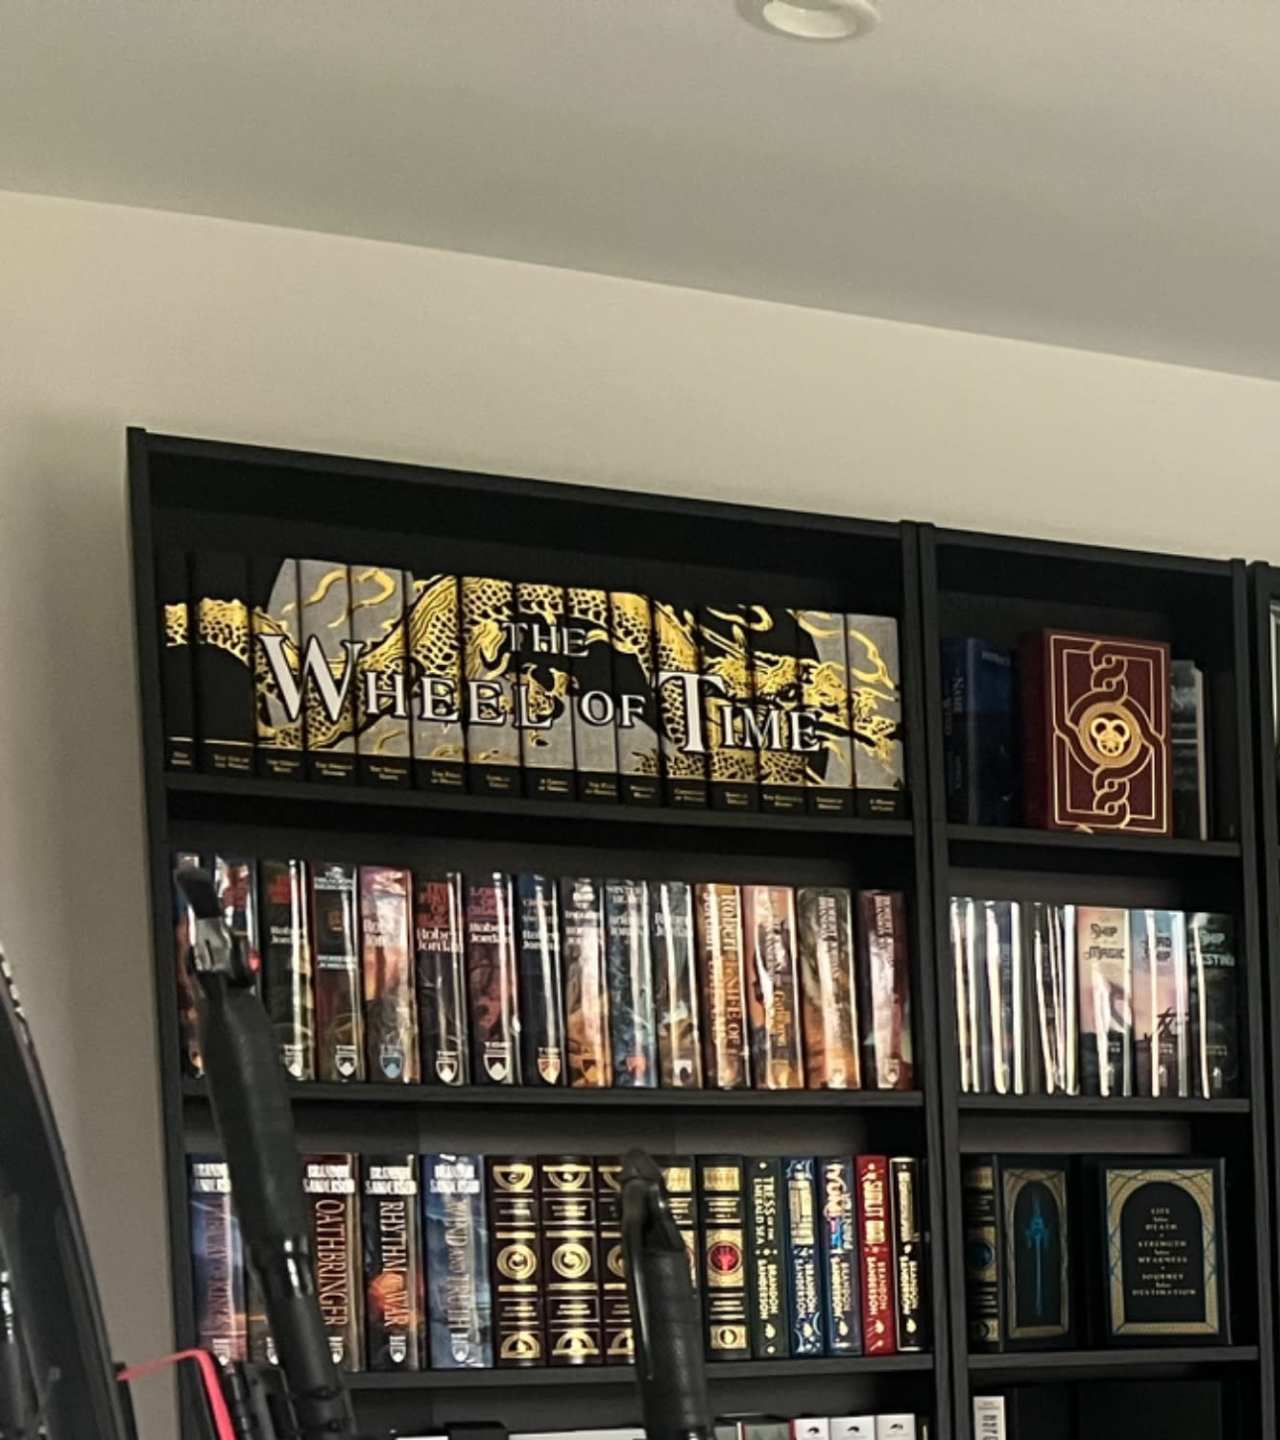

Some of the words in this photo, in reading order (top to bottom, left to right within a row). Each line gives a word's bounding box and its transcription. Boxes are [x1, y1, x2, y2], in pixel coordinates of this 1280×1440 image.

[501, 621, 589, 657] THE
[259, 633, 558, 729] WHEEL
[581, 689, 645, 729] OF
[658, 671, 821, 753] TIME
[753, 1178, 765, 1223] EMERALD
[763, 1177, 774, 1216] TRESS
[380, 1201, 408, 1272] RHYTHM
[756, 1226, 765, 1245] SEA
[316, 1200, 348, 1326] OATHBRINGER
[866, 1256, 879, 1315] SANDERSON
[877, 1261, 886, 1310] BRANDON
[383, 1291, 409, 1327] WAR
[757, 1259, 769, 1319] SANDERSON
[768, 1265, 777, 1314] BRANDON
[795, 1259, 806, 1318] SANDERSON
[805, 1263, 815, 1313] BRANDON
